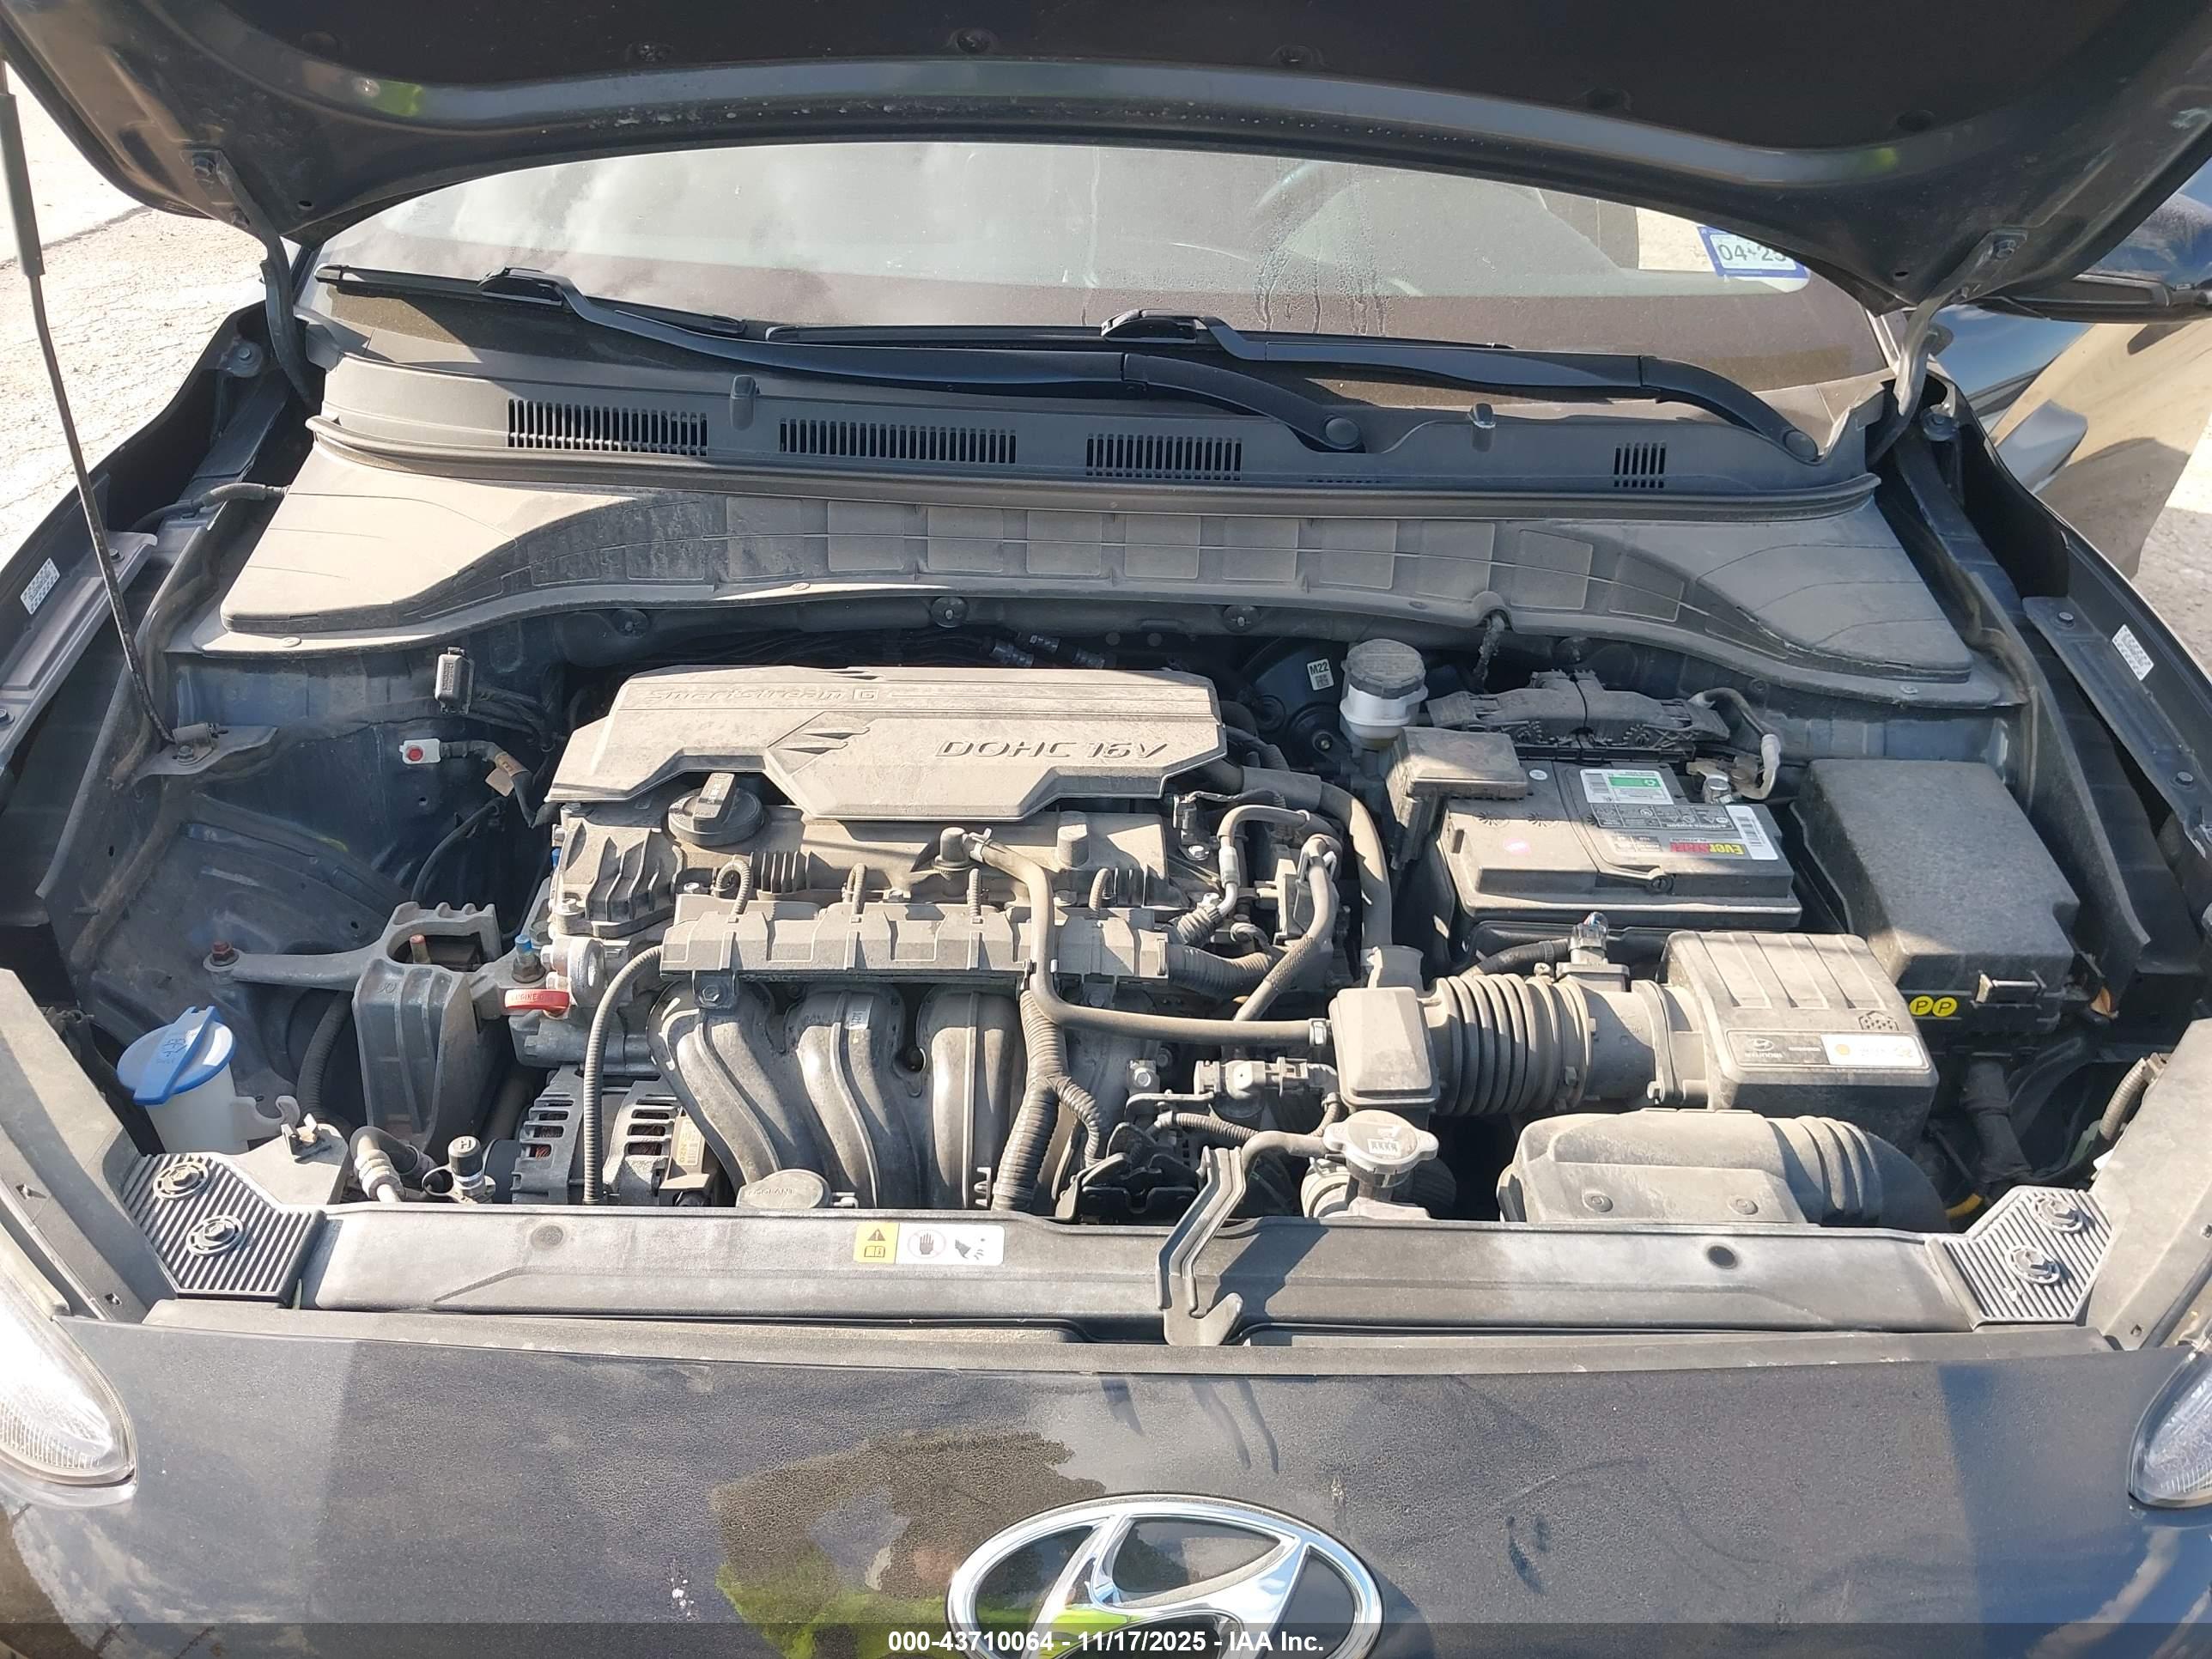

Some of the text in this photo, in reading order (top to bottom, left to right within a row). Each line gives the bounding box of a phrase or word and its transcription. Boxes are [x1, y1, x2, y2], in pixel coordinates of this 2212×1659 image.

[1309, 661, 1329, 675] M22
[935, 741, 1169, 758] DOHC 16V
